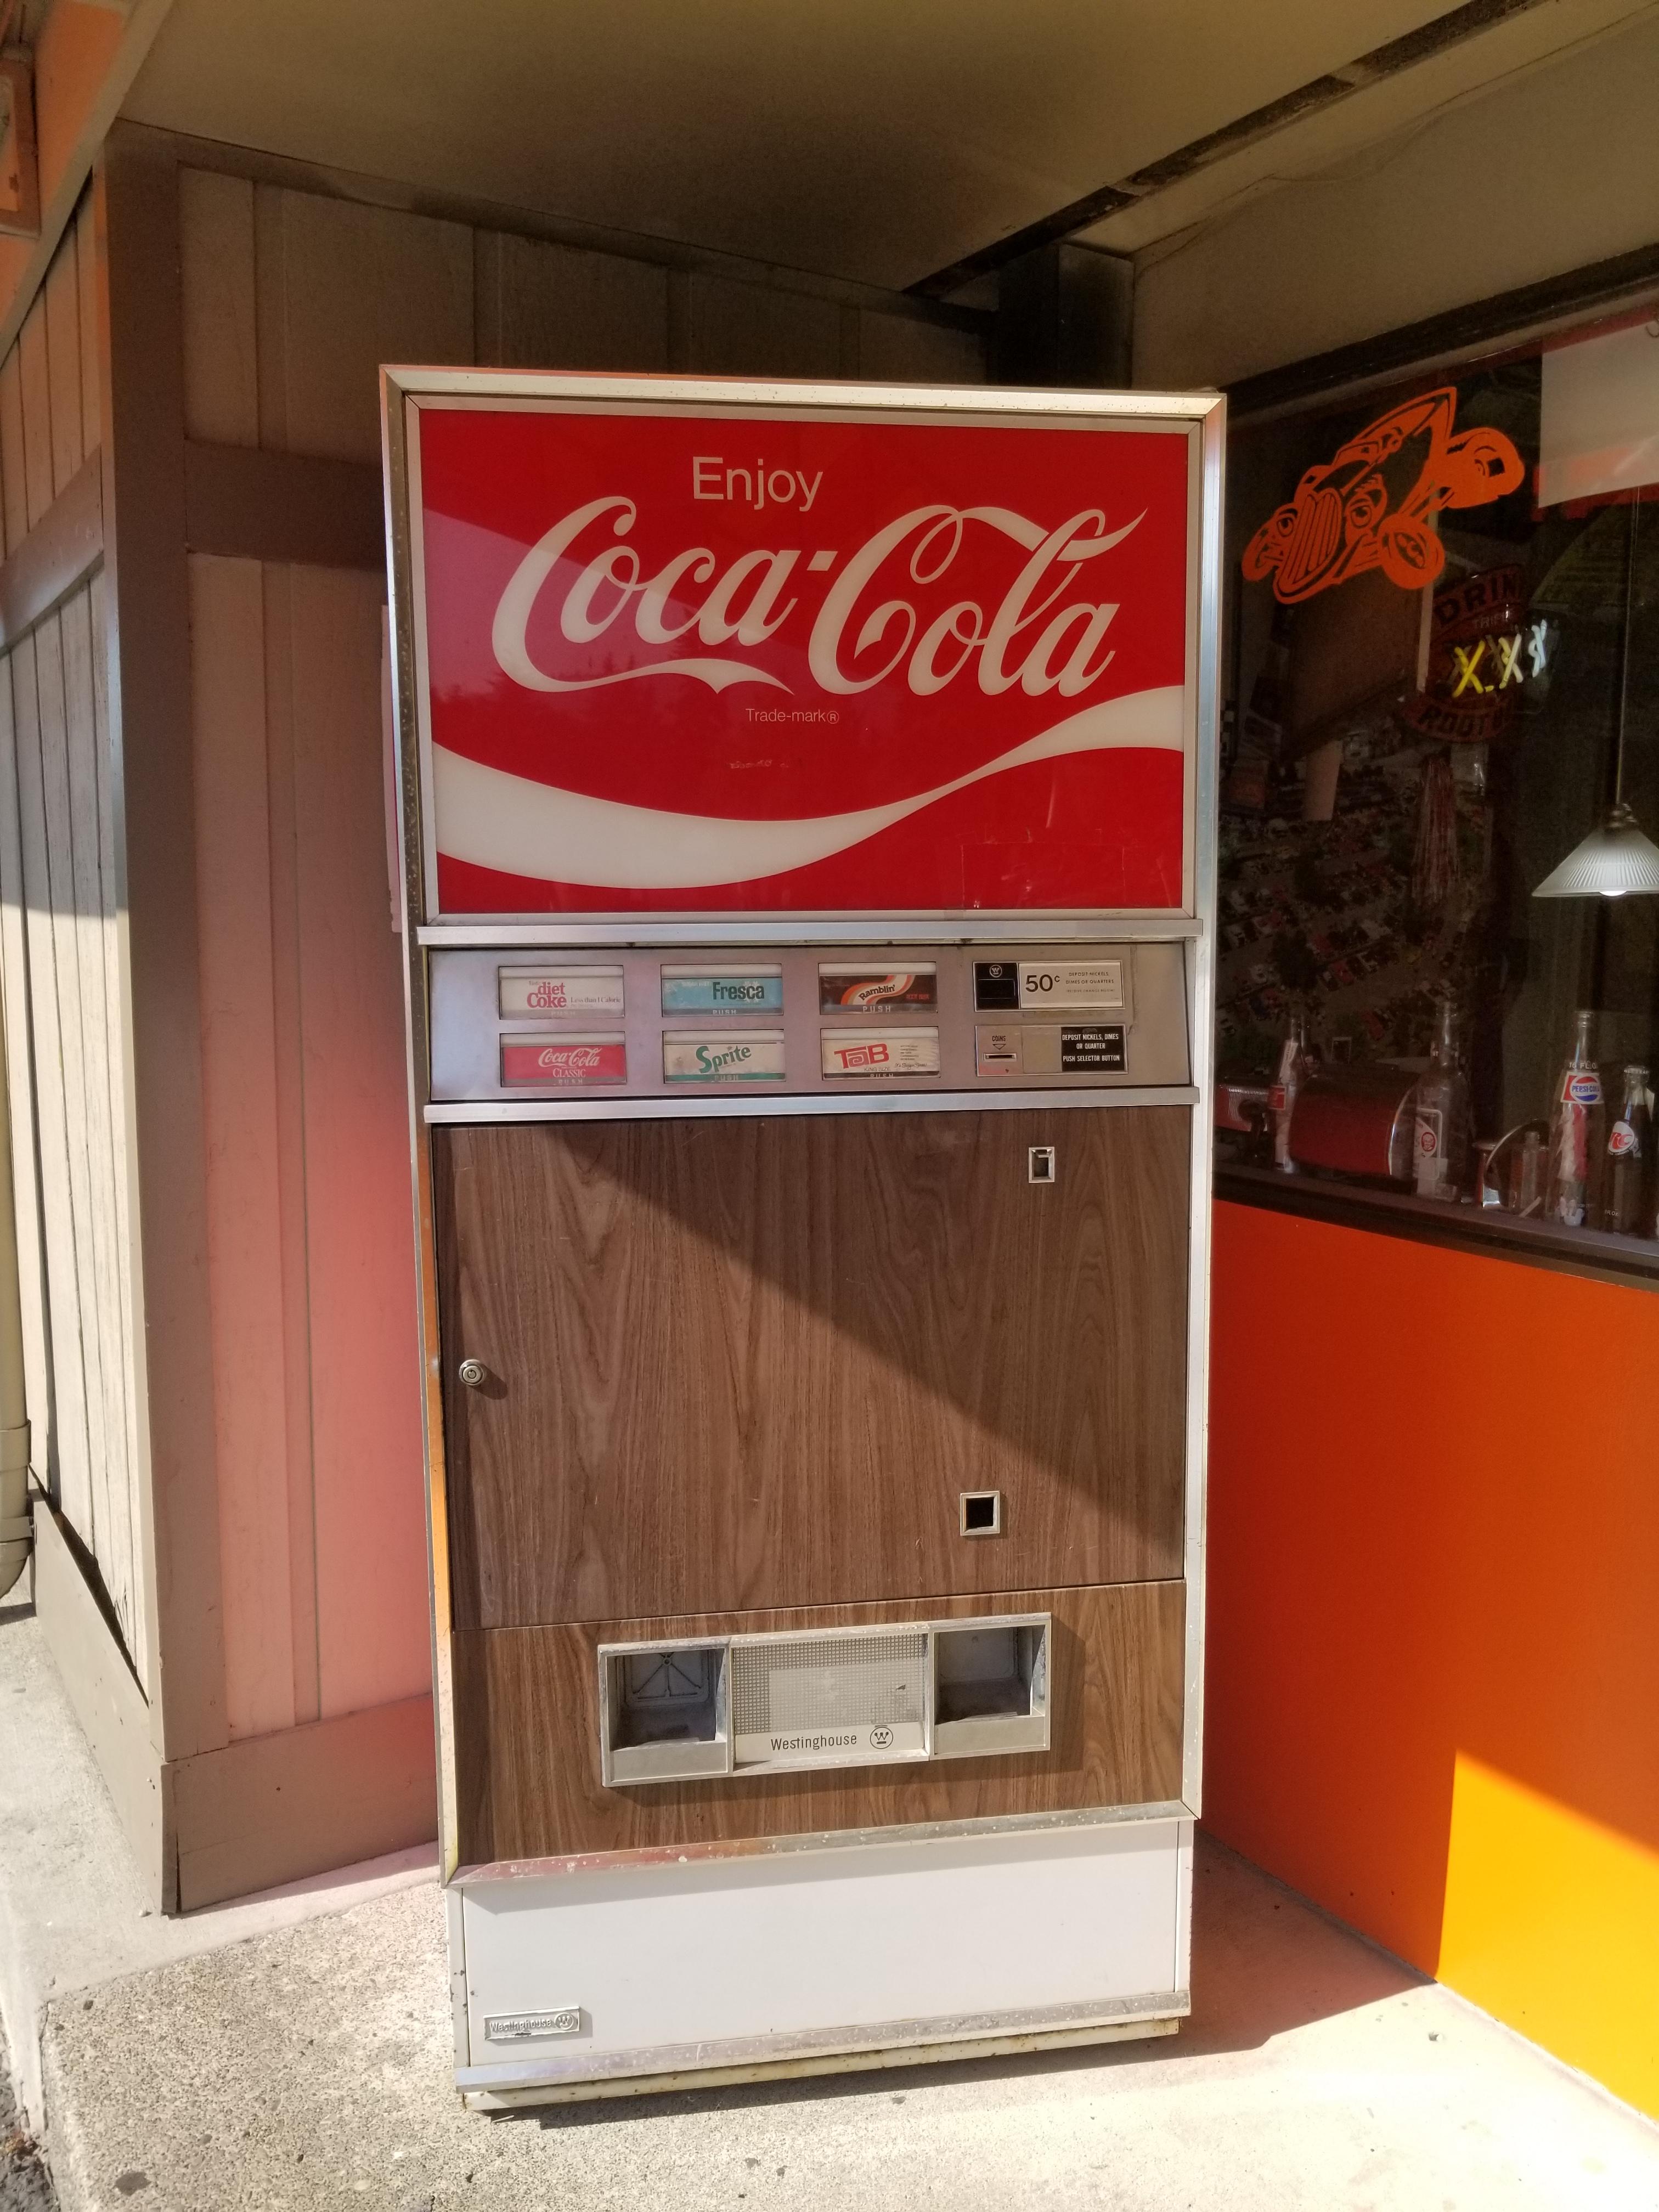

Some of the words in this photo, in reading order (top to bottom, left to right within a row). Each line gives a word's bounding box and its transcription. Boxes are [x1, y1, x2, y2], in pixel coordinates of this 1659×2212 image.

[692, 455, 823, 512] Enjoy
[491, 494, 1148, 697] Coca-Cola
[538, 981, 565, 996] diet
[713, 981, 765, 1000] Fresca
[858, 984, 895, 1001] Ramblin'
[527, 992, 567, 1008] Coke
[538, 1048, 602, 1068] Coca-Cola
[696, 1045, 752, 1074] Sprite
[552, 1068, 586, 1078] CLASSIC
[771, 1735, 857, 1751] Westinghouse
[489, 2018, 552, 2032] Westinghouse
